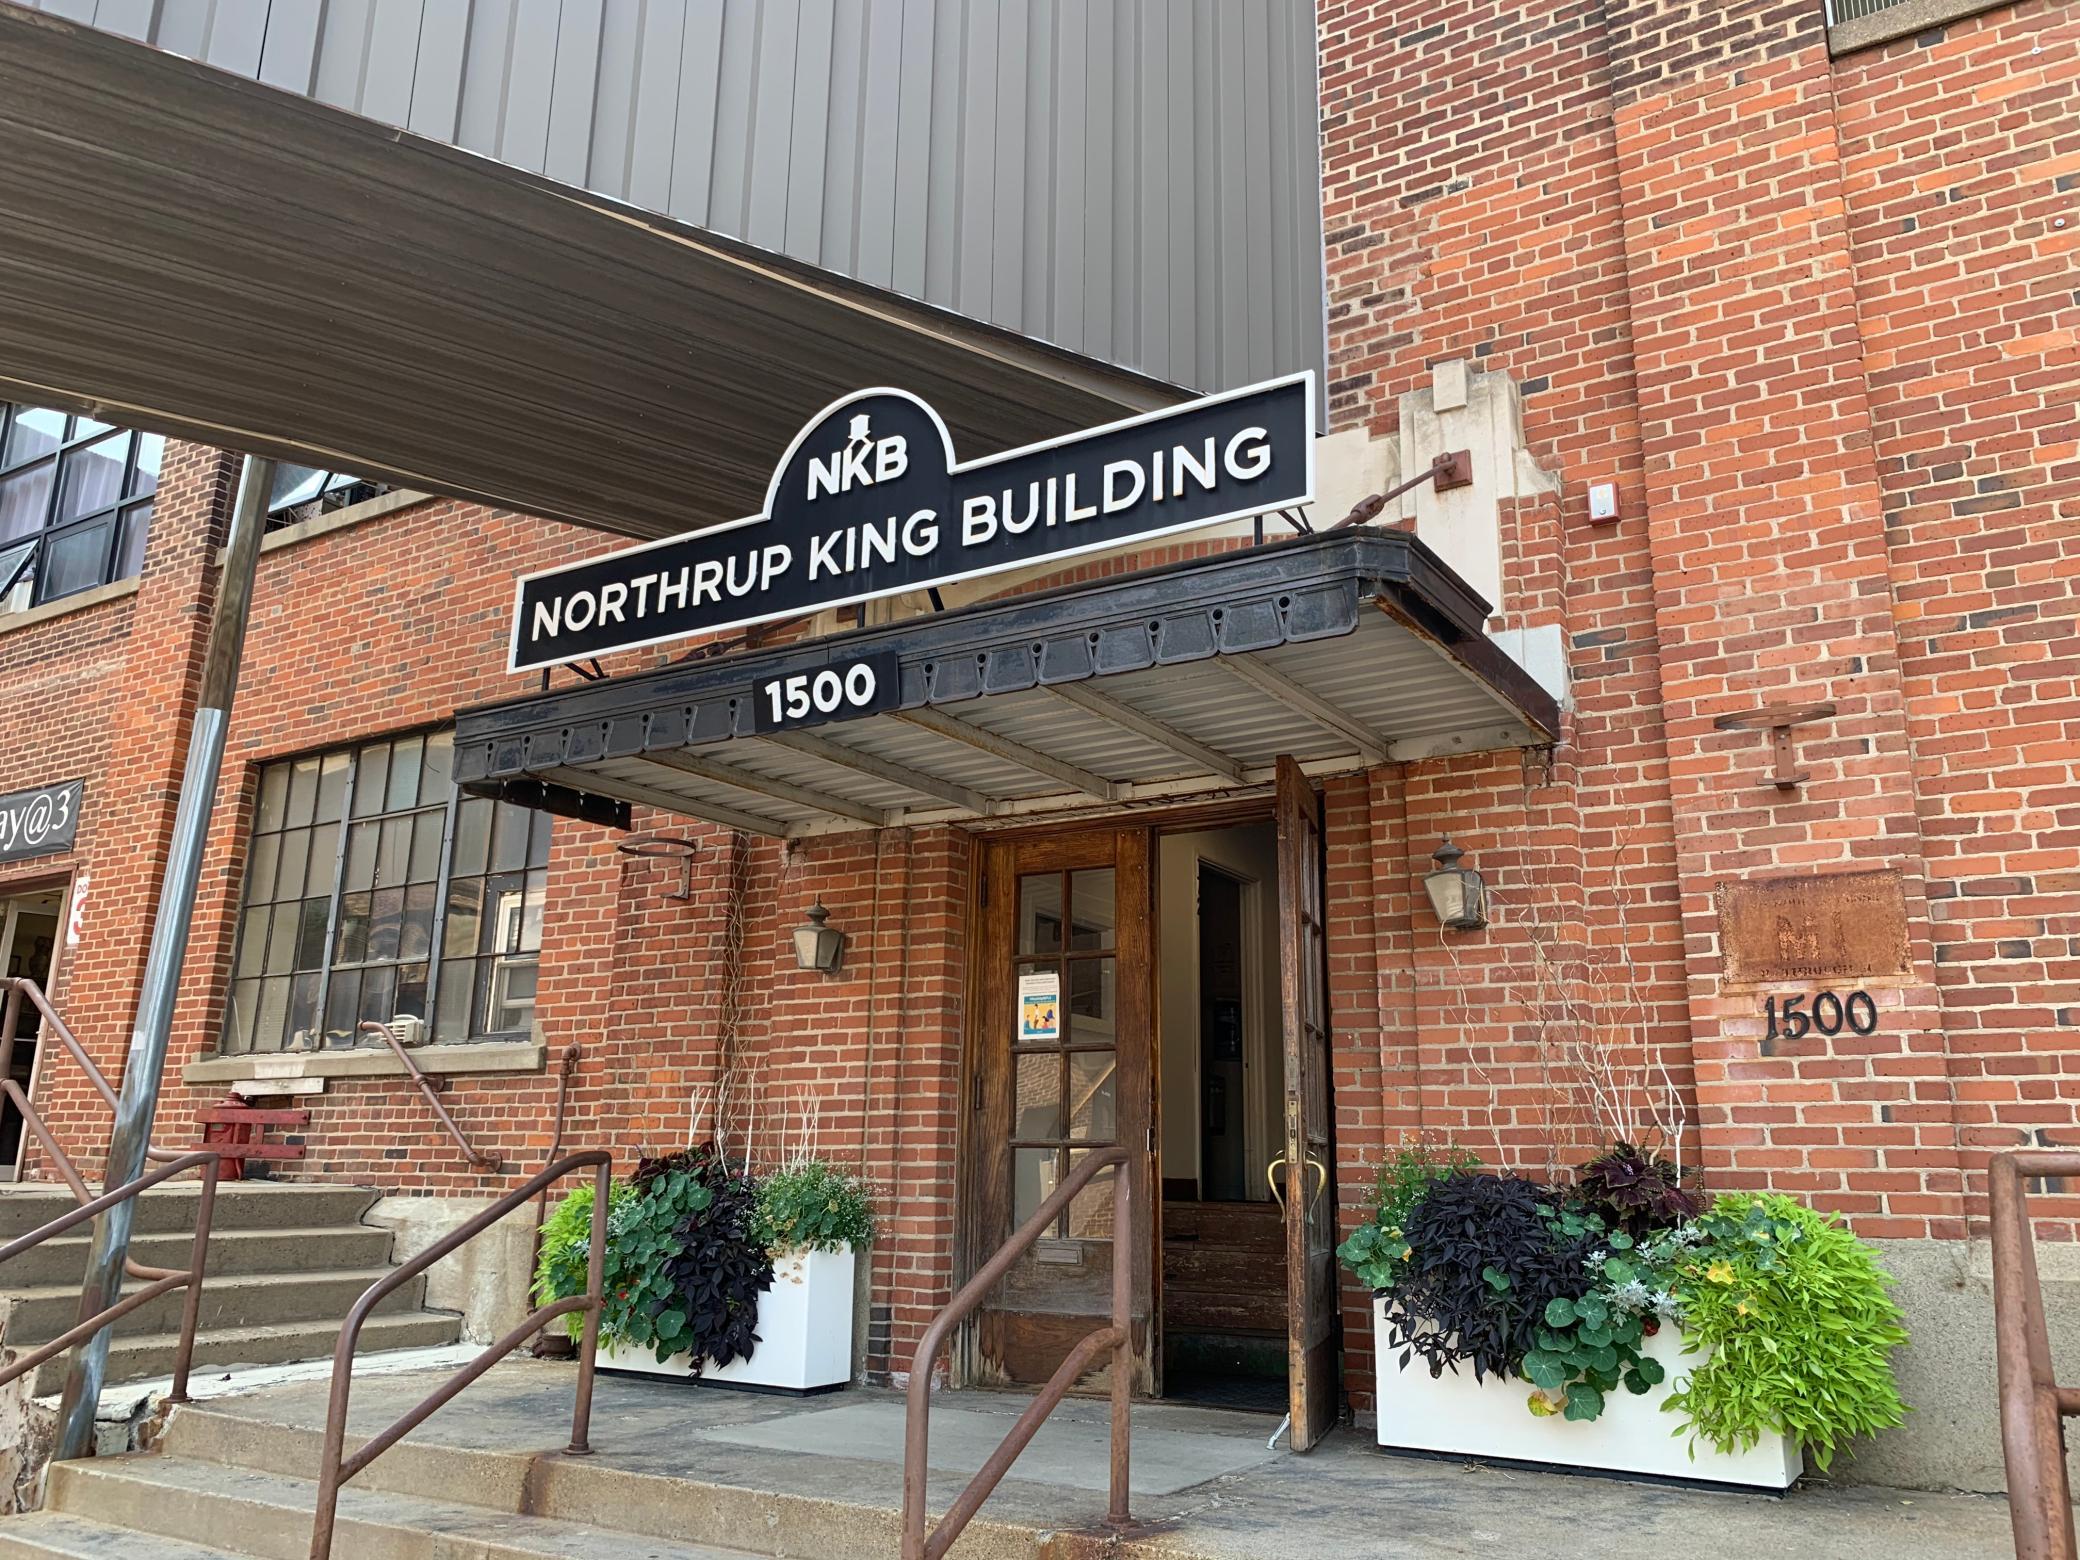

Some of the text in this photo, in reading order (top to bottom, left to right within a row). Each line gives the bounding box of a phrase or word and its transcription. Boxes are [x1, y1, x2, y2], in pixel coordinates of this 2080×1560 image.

[806, 434, 909, 501] NKB
[530, 425, 1272, 642] NORTHRUP KING BUILDING
[763, 662, 877, 726] 1500
[1763, 990, 1878, 1041] 1500
